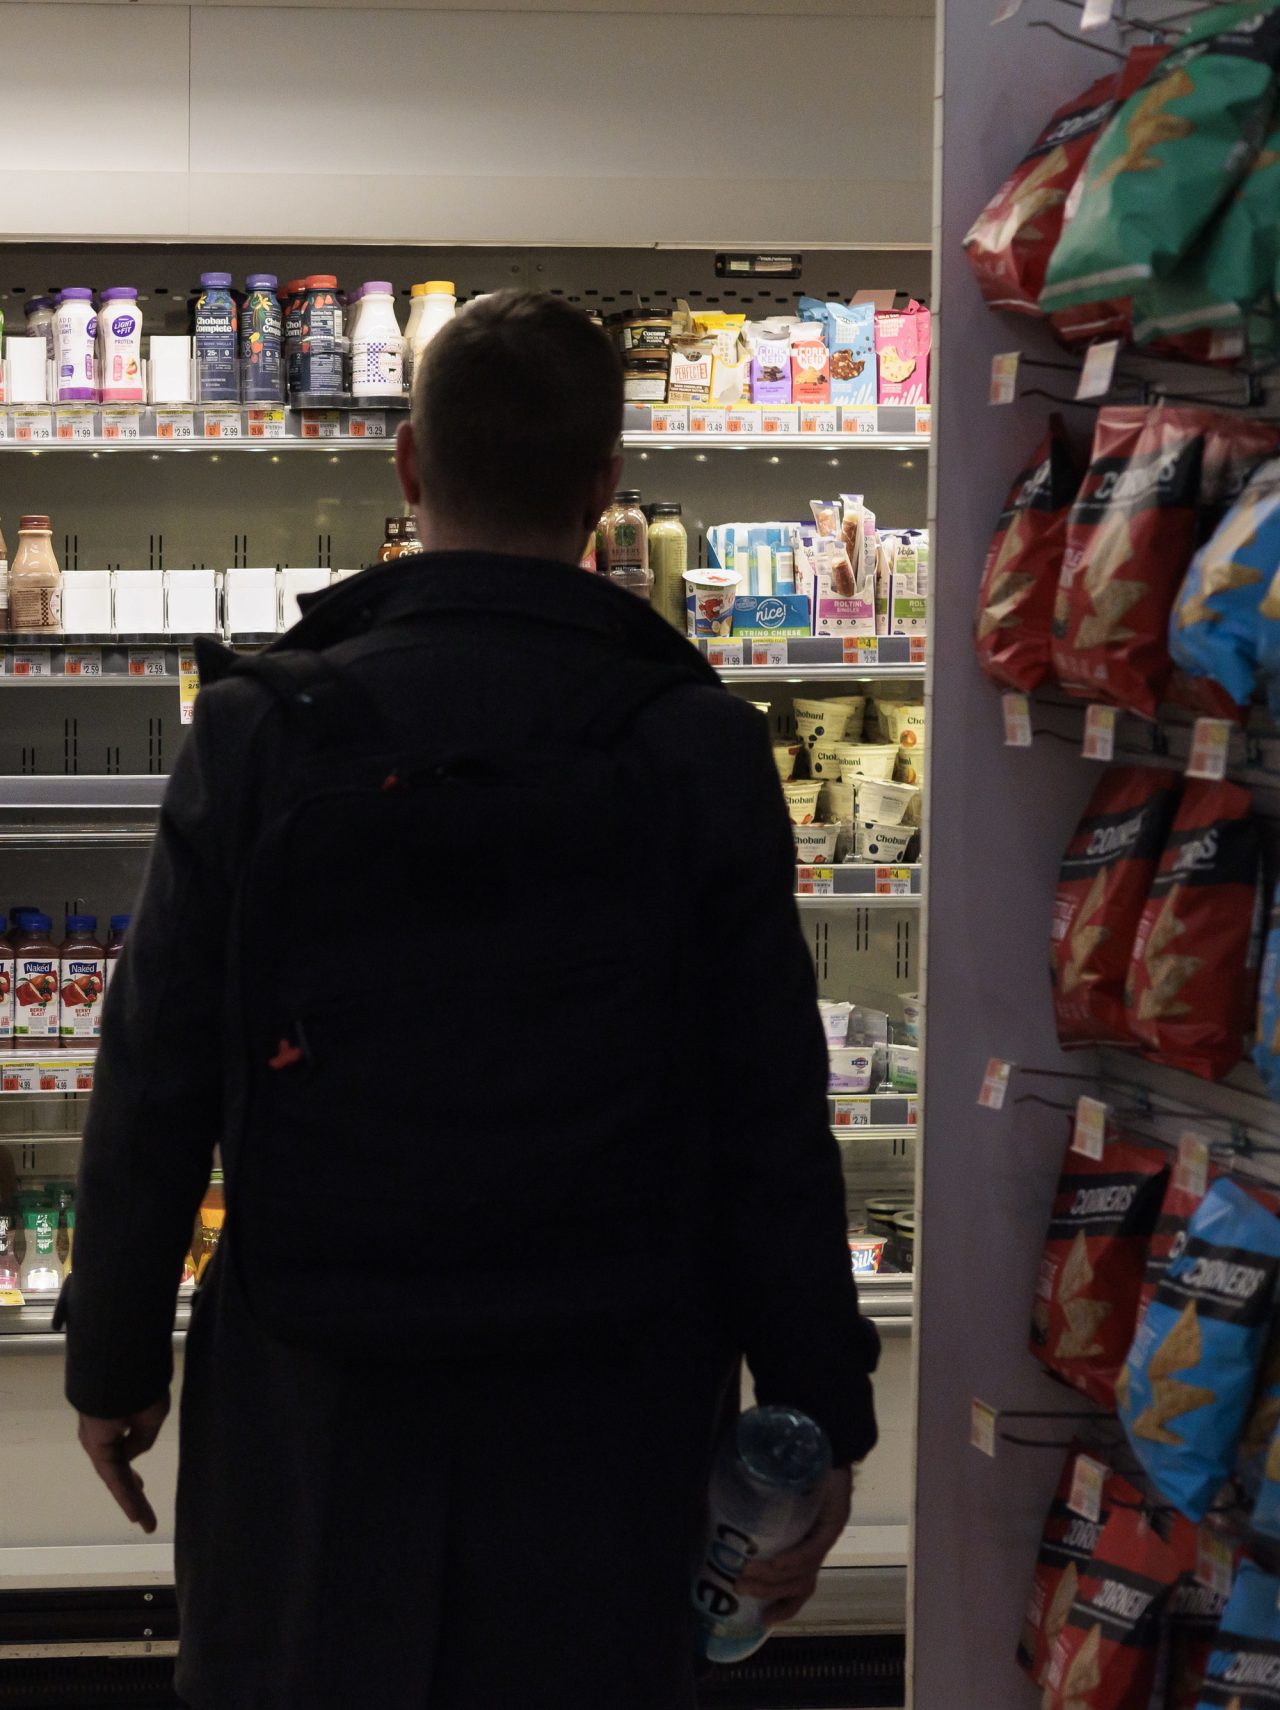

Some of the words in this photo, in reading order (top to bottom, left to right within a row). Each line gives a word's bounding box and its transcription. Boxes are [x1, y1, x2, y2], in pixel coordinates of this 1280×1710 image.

[196, 316, 229, 325] Chobani
[196, 324, 232, 333] Complete
[755, 604, 786, 622] nice!
[876, 834, 908, 846] Chobani
